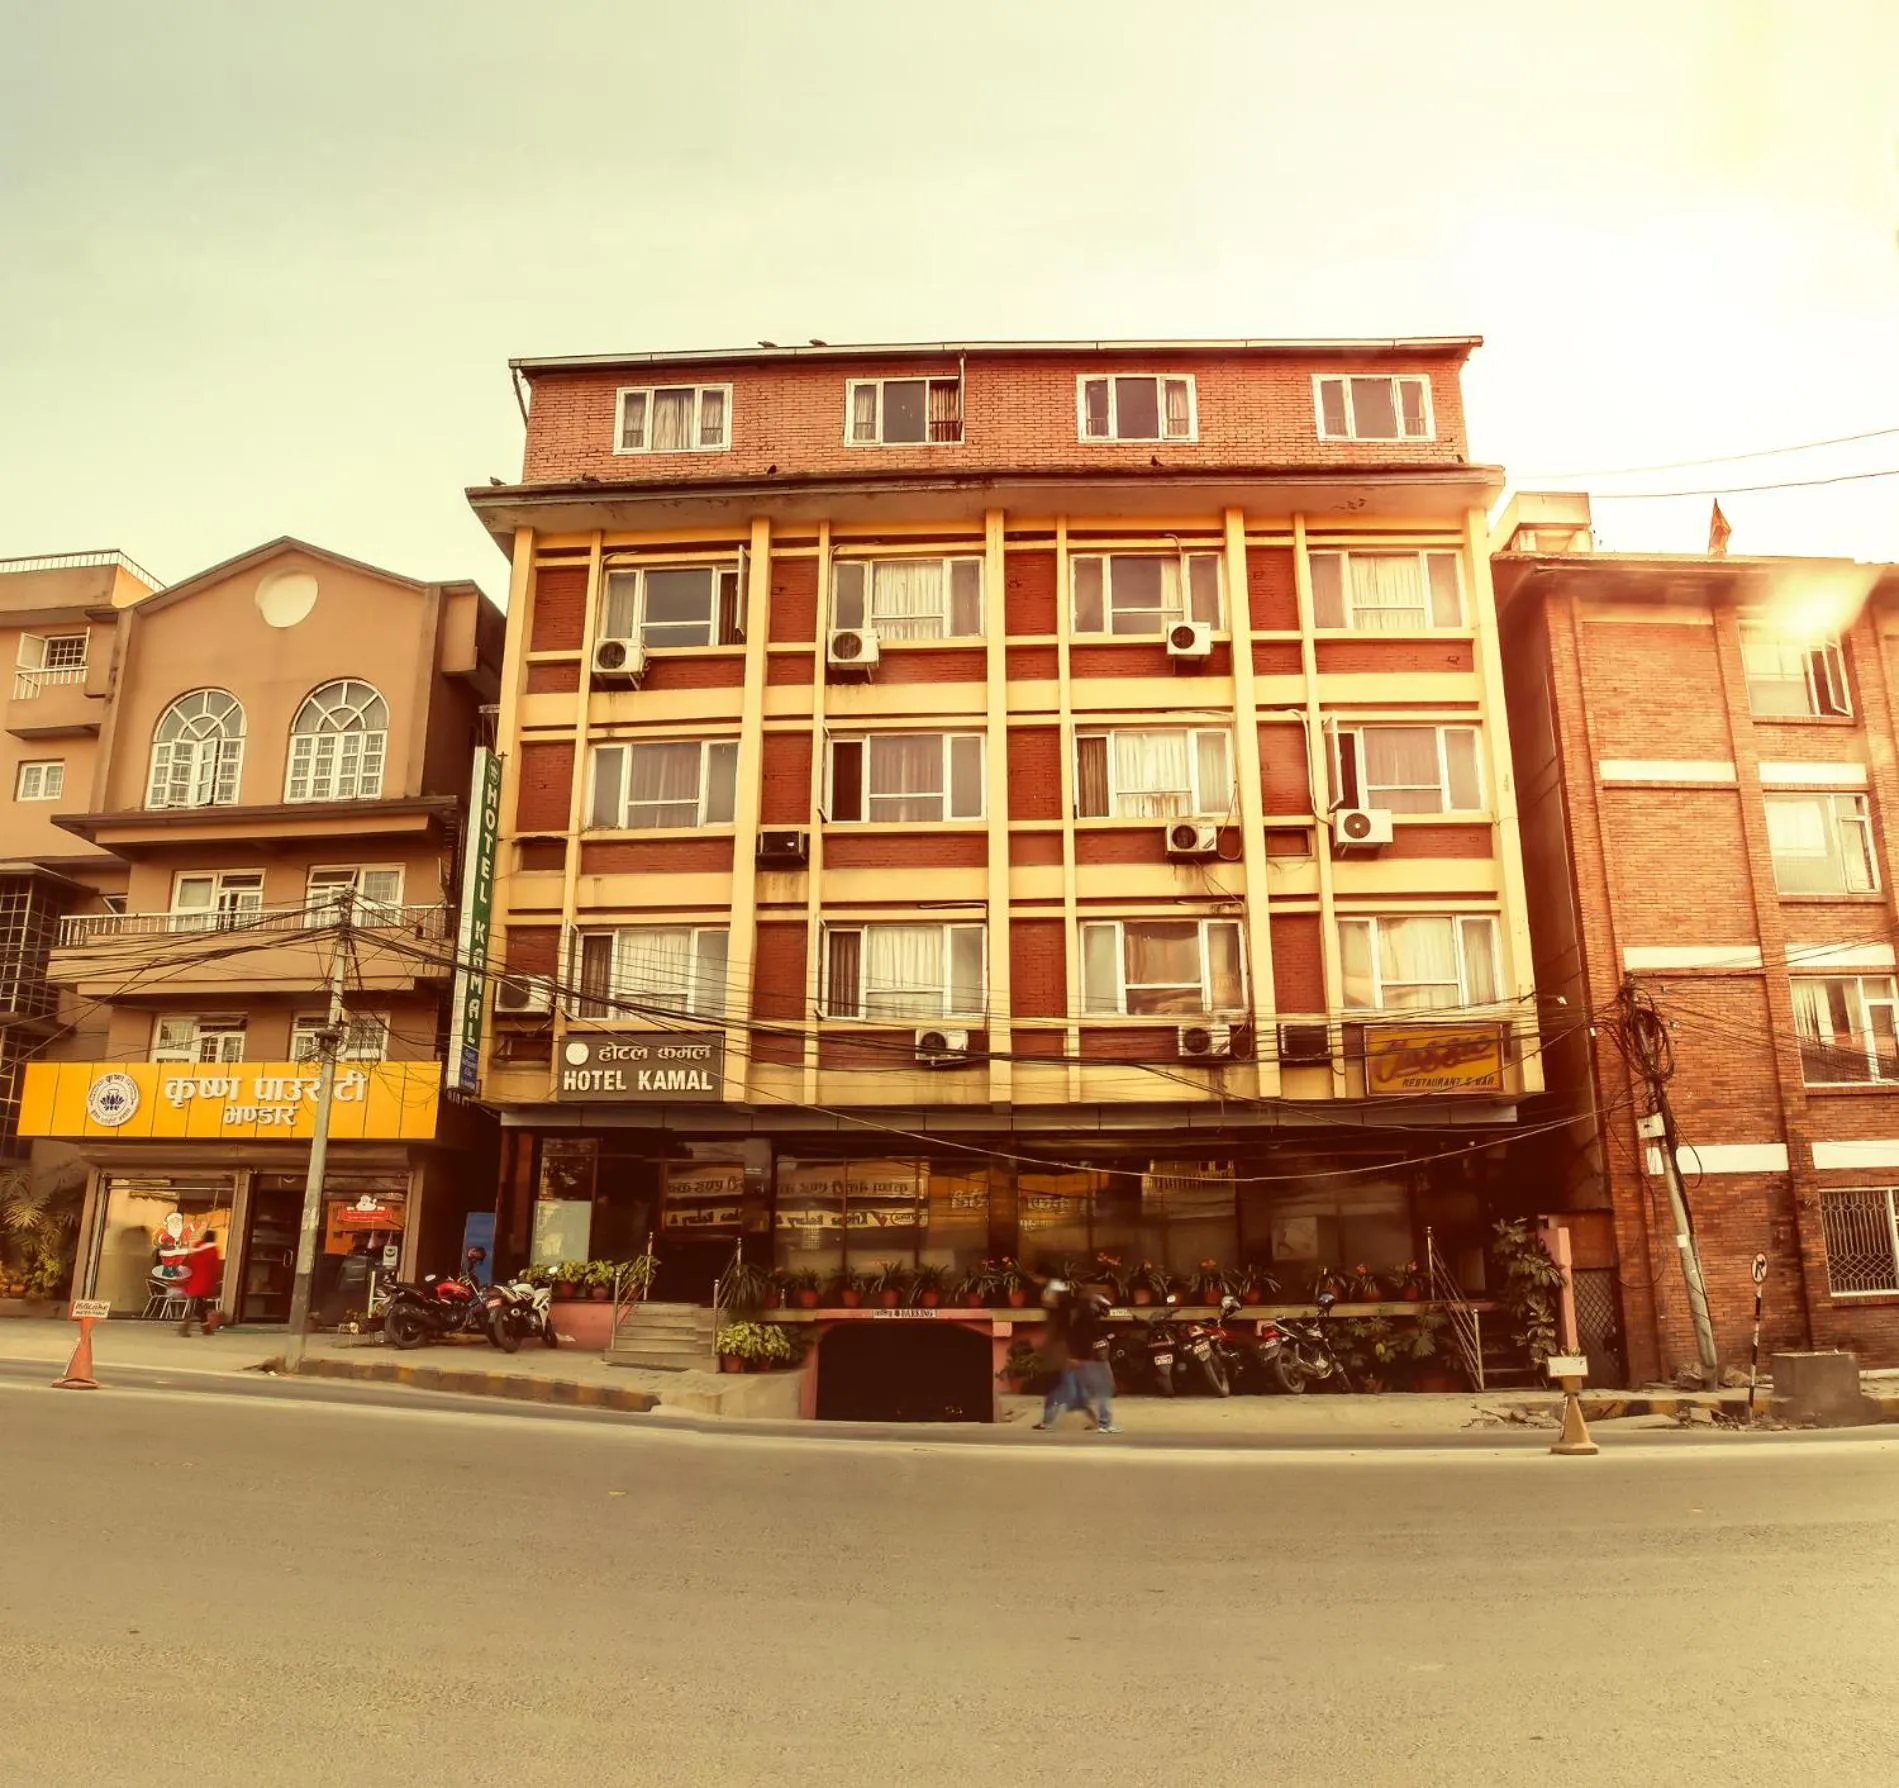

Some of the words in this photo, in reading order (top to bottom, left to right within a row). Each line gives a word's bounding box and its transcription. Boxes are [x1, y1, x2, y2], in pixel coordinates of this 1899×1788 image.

[479, 784, 498, 904] HOTEL
[467, 919, 486, 1044] KAMAL
[598, 1042, 649, 1061] होटल
[657, 1044, 711, 1060] कमल
[164, 1075, 242, 1107] कृष्ण
[253, 1069, 369, 1103] पाउरटी
[563, 1069, 627, 1091] HOTEL
[638, 1069, 713, 1091] KAMAL
[1402, 1076, 1461, 1089] RESTAURANT
[224, 1105, 302, 1126] भण्डार
